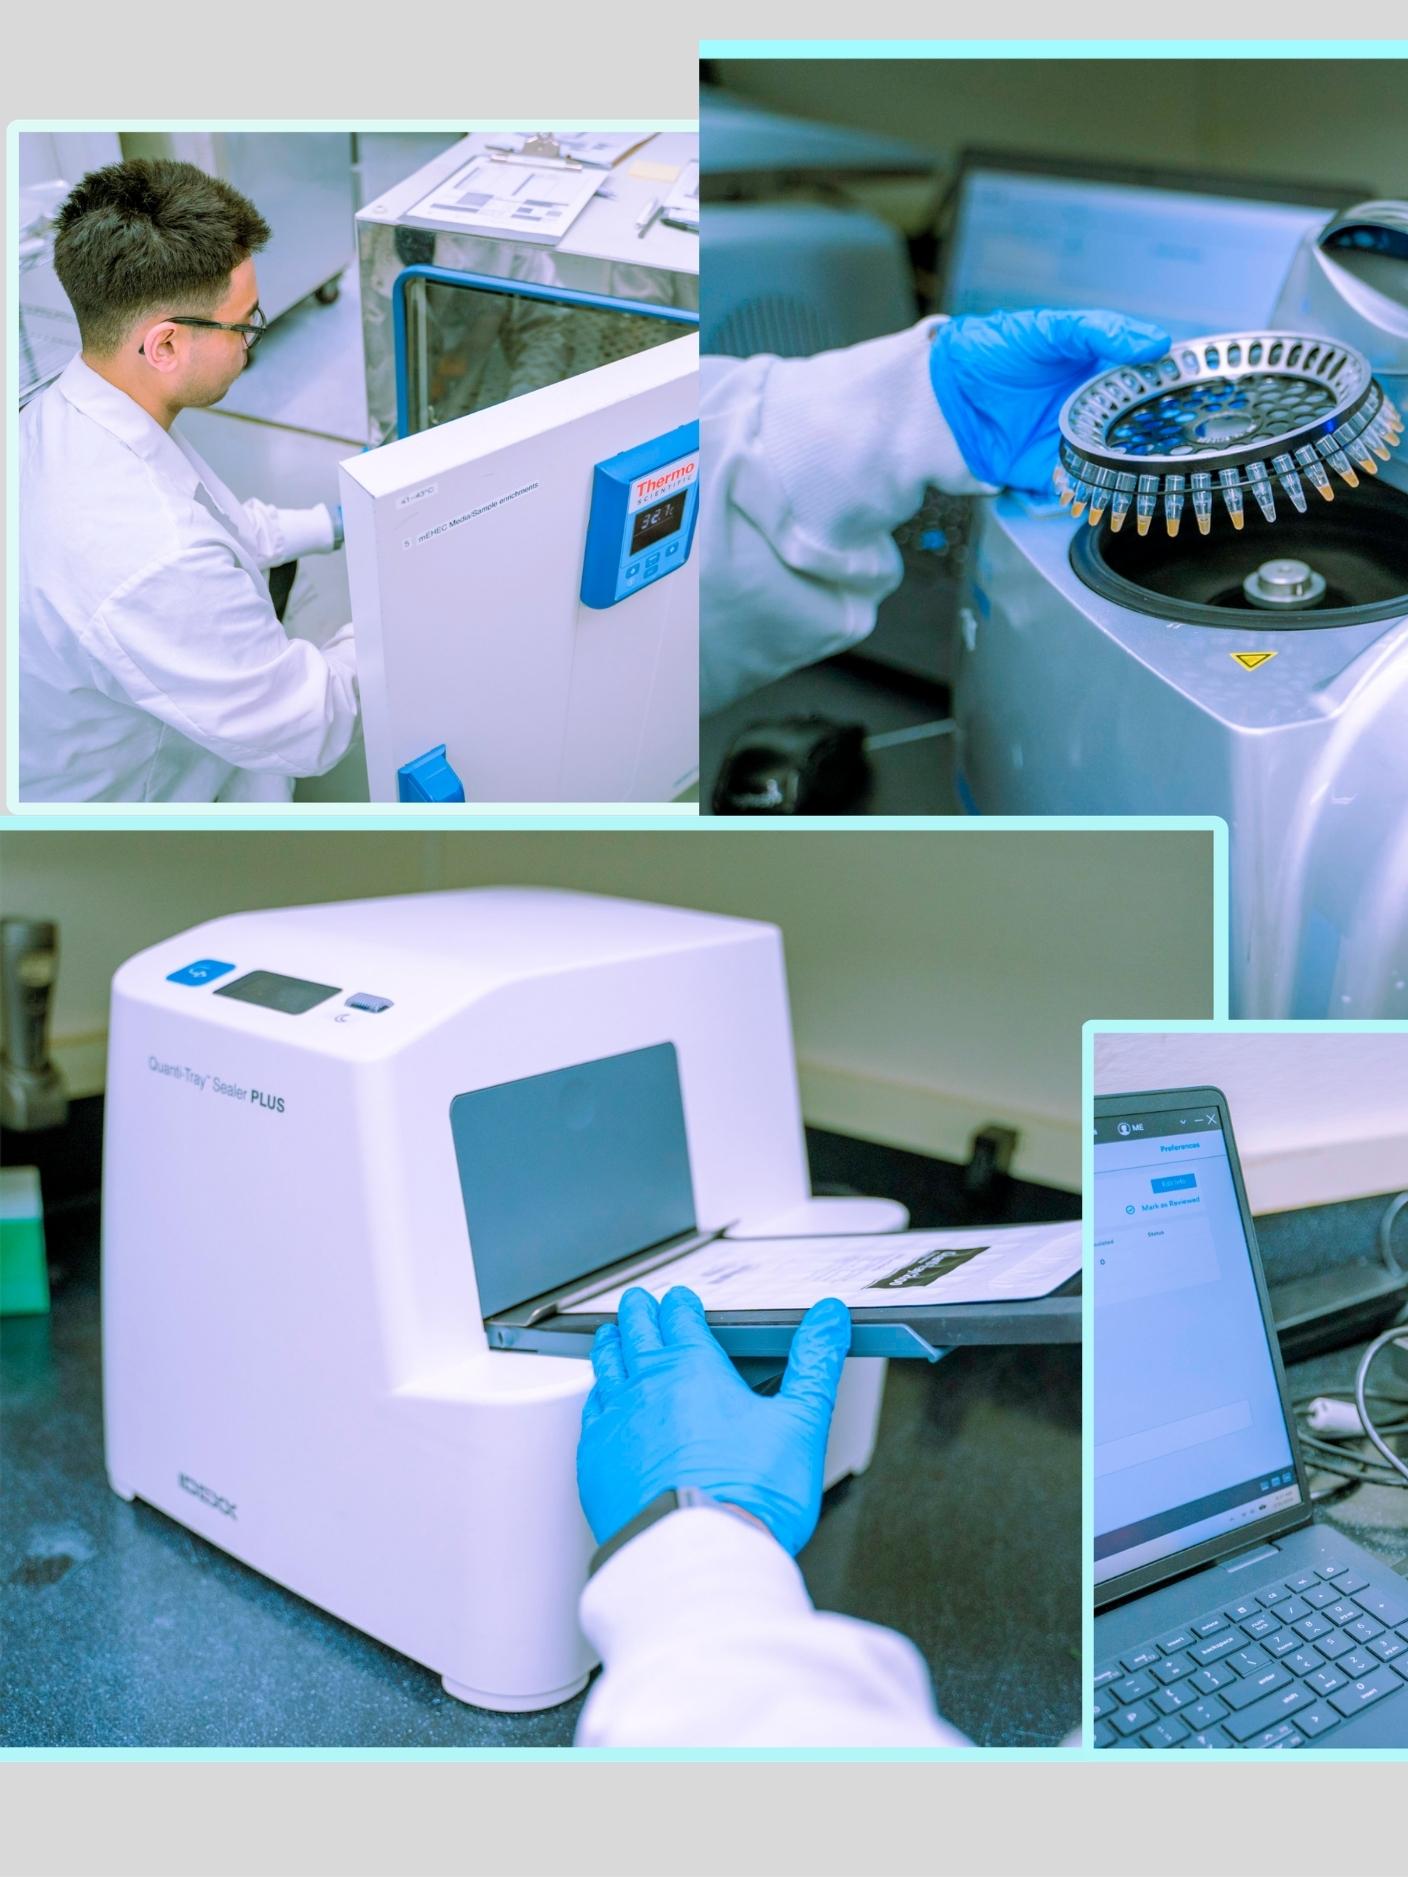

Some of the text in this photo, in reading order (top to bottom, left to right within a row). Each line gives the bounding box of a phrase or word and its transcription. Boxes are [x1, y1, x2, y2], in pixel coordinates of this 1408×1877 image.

[637, 463, 695, 497] Thermo
[637, 475, 692, 505] SCIENTIFIC
[499, 482, 539, 505] enrichments
[212, 1076, 247, 1101] Sealer
[251, 1089, 285, 1113] PLUS
[1160, 1142, 1200, 1153] Preferences
[1141, 1203, 1159, 1212] Mark
[1169, 1196, 1200, 1207] Reviewed
